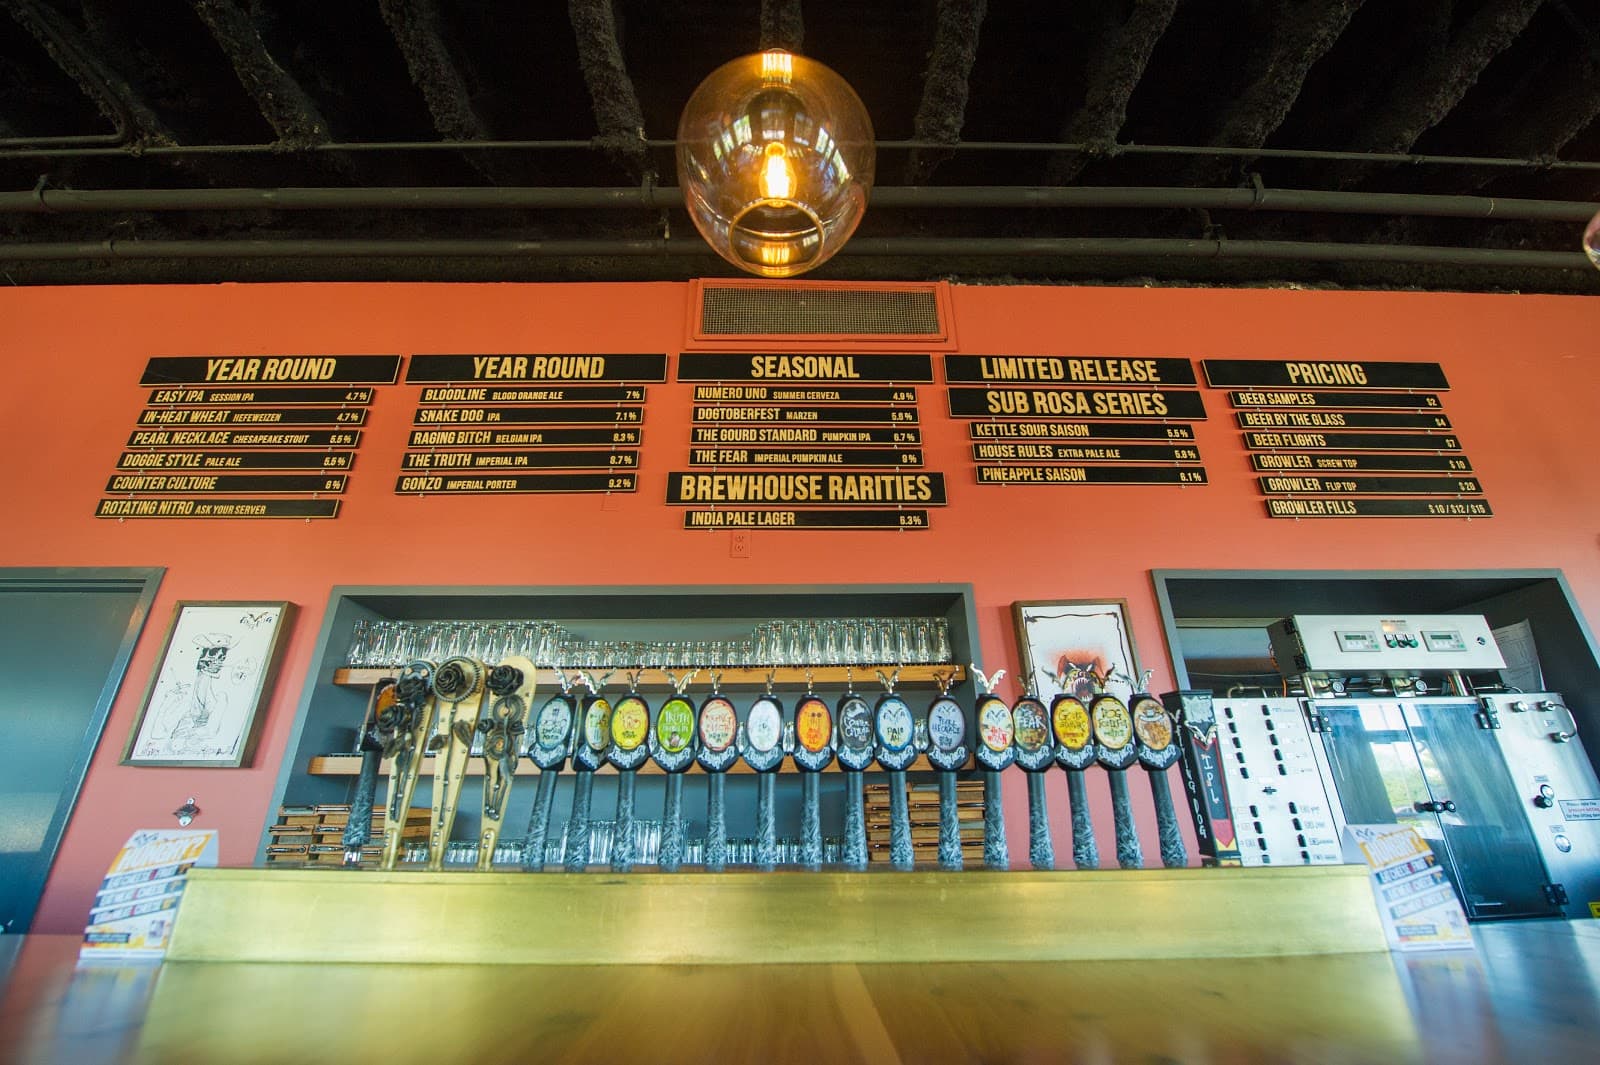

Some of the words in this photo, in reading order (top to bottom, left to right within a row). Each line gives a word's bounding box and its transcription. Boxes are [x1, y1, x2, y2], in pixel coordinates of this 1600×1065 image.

[204, 359, 264, 380] YEAR
[262, 358, 337, 380] ROUND
[473, 357, 530, 378] YEAR
[533, 357, 604, 378] ROUND
[751, 356, 860, 378] SEASONAL
[980, 358, 1063, 379] LIMITED
[1070, 359, 1160, 382] RELEASE
[1286, 363, 1368, 385] PRICING
[155, 391, 185, 402] EASY
[185, 390, 204, 402] IPA
[209, 393, 241, 402] SESSION
[241, 393, 254, 401] IPA
[425, 389, 487, 400] BLOODLINE
[492, 392, 517, 400] BLOOD
[697, 388, 742, 399] NUMERO
[745, 388, 767, 399] UNO
[773, 391, 805, 399] SUMMER
[1240, 393, 1267, 404] BEER
[1267, 394, 1315, 405] SAMPLES
[987, 391, 1029, 414] SUB
[1033, 391, 1092, 414] ROSA
[1095, 392, 1168, 415] SERIES
[143, 412, 189, 422] IN-HEAT
[189, 411, 231, 422] WHEAT
[232, 414, 281, 422] HEFEWEIZEN
[420, 410, 458, 422] SNAKE
[460, 410, 483, 421] DOG
[487, 413, 500, 421] IPA
[698, 408, 780, 420] DOGTOBERFEST
[786, 412, 818, 420] MARZEN
[1247, 414, 1274, 425] BEER
[1276, 414, 1289, 425] BY
[1289, 414, 1310, 425] THE
[1311, 414, 1346, 426] GLASS
[697, 429, 718, 441] THE
[720, 429, 757, 441] GOURD
[759, 429, 817, 441] STANDARD
[822, 433, 857, 441] PUMPKIN
[858, 433, 871, 441] IPA
[976, 424, 1017, 436] KETTLE
[1020, 424, 1048, 436] SOUR
[1050, 425, 1089, 436] SAISON
[133, 433, 170, 444] PEARL
[170, 432, 229, 444] NECKLACE
[232, 435, 283, 444] CHESAPEAKE
[283, 435, 309, 443] STOUT
[414, 432, 455, 444] RAGING
[457, 432, 491, 443] BITCH
[496, 434, 528, 443] BELGIAN
[529, 434, 542, 442] IPA
[1254, 434, 1282, 446] BEER
[1284, 434, 1326, 446] FLIGHTS
[696, 451, 717, 463] THE
[720, 450, 748, 462] FEAR
[755, 454, 790, 463] IMPERIAL
[792, 454, 827, 463] PUMPKIN
[827, 454, 842, 463] ALE
[979, 445, 1016, 458] HOUSE
[1018, 446, 1053, 458] RULES
[1058, 450, 1084, 458] EXTRA
[1085, 450, 1106, 458] PALE
[1106, 450, 1120, 458] ALE
[122, 455, 164, 466] DOGGIE
[164, 454, 204, 466] STYLE
[205, 458, 224, 466] PALE
[224, 458, 241, 466] ALE
[408, 454, 431, 466] THE
[434, 454, 471, 466] TRUTH
[475, 457, 513, 465] IMPERIAL
[514, 456, 528, 465] IPA
[1261, 455, 1312, 468] GROWLER
[1317, 459, 1342, 468] SCREW
[1343, 459, 1357, 468] TOP
[983, 468, 1043, 481] PINEAPPLE
[1046, 468, 1086, 481] SAISON
[112, 477, 167, 489] COUNTER
[167, 477, 218, 489] CULTURE
[402, 478, 442, 490] GONZO
[447, 481, 484, 489] IMPERIAL
[486, 480, 517, 489] PORTER
[681, 475, 822, 500] BREWHOUSE
[829, 476, 932, 500] RARITIES
[1268, 478, 1321, 490] GROWLER
[1326, 482, 1341, 491] FLIP
[1340, 482, 1357, 491] TOP
[101, 502, 158, 514] ROTATING
[160, 502, 194, 514] NITRO
[195, 505, 212, 514] ASK
[212, 505, 235, 514] YOUR
[235, 505, 266, 514] SERVER
[1272, 500, 1326, 514] GROWLER
[1328, 500, 1356, 514] FILLS
[692, 512, 724, 525] INDIA
[726, 512, 755, 525] PALE
[758, 512, 795, 525] LAGER
